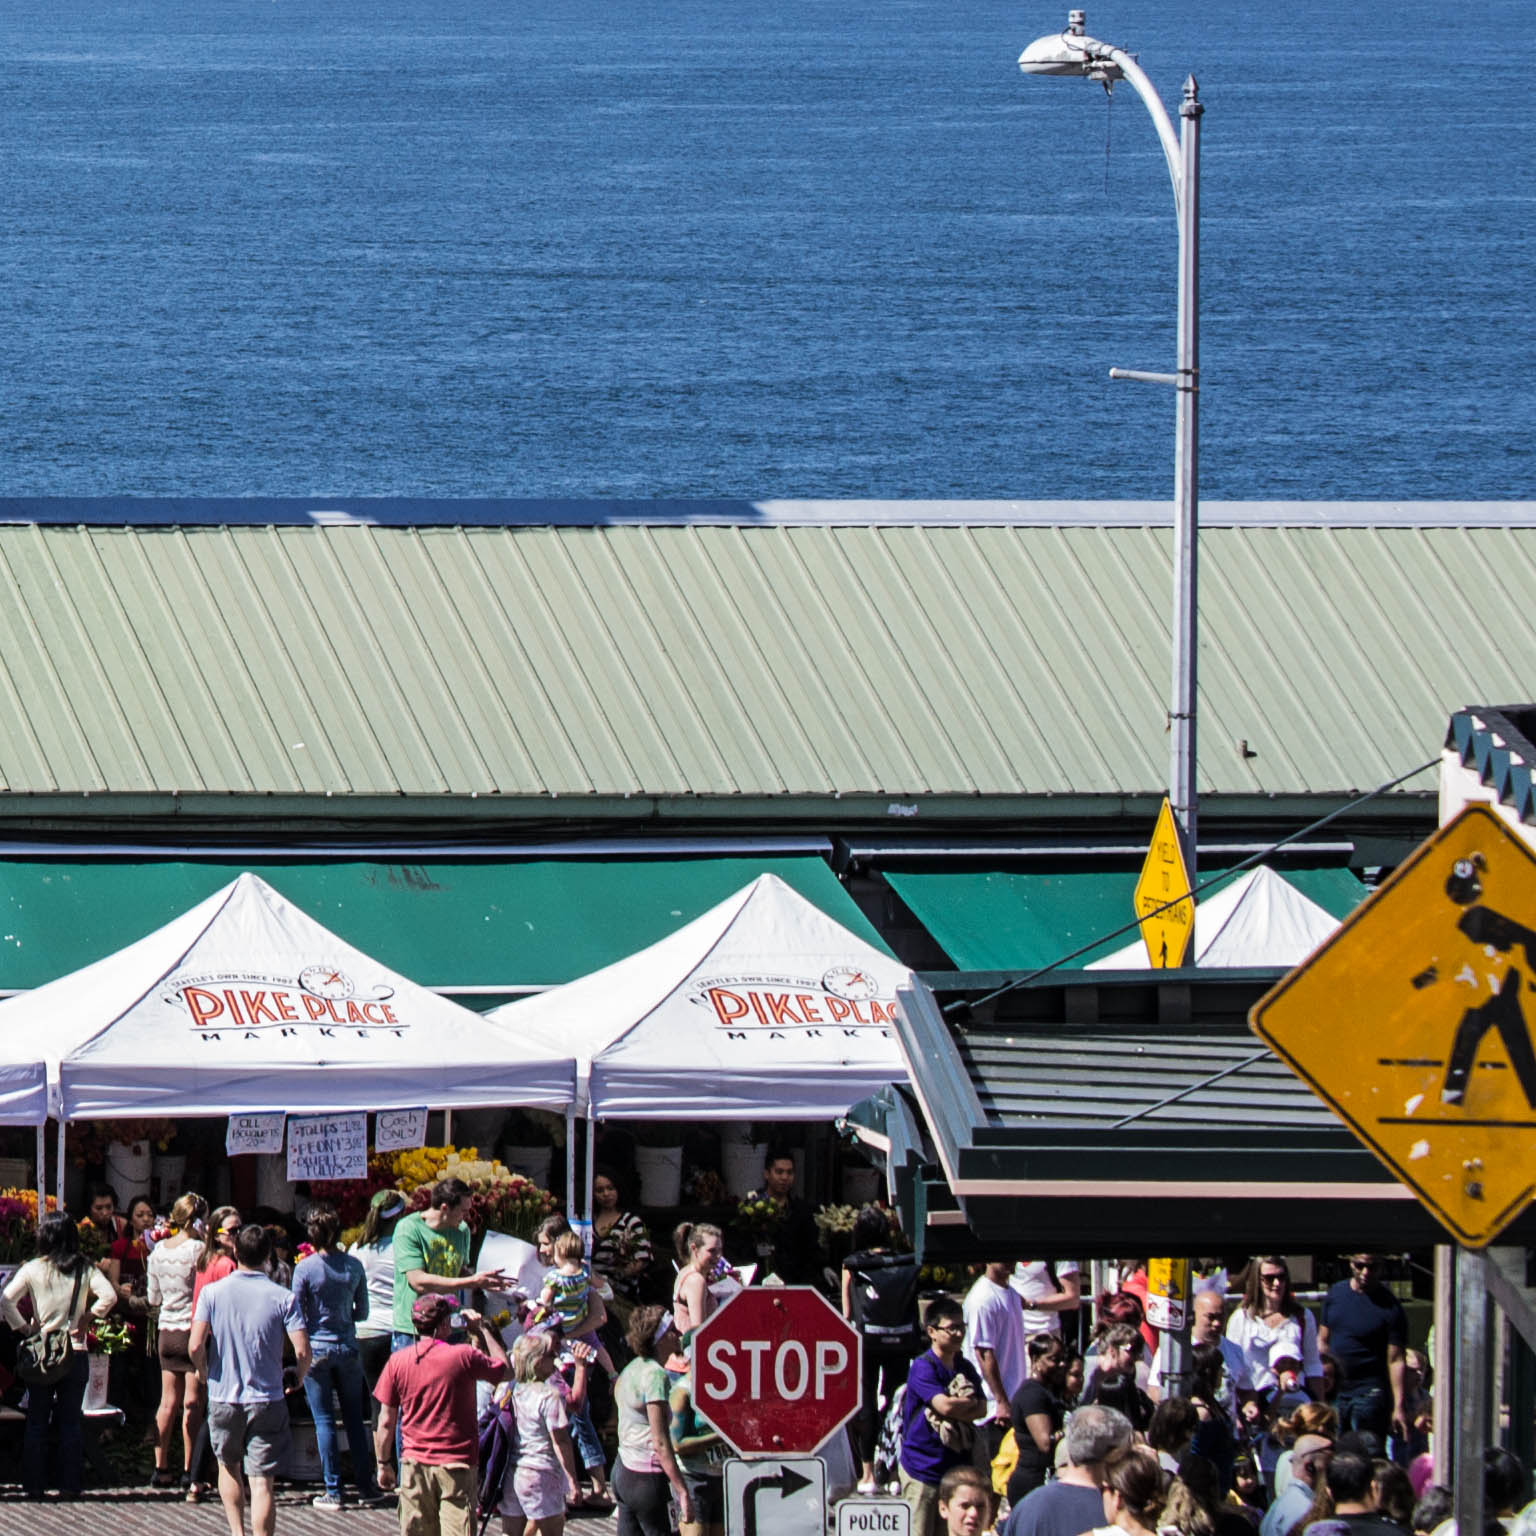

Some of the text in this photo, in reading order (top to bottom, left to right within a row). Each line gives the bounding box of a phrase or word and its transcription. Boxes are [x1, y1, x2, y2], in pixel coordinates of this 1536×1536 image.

[182, 986, 399, 1026] PIKE PLACE
[707, 987, 823, 1025] PIKE
[201, 1028, 404, 1041] MARKET
[727, 1029, 894, 1040] MARKE
[380, 1112, 417, 1130] Cash
[704, 1339, 849, 1400] STOP
[849, 1514, 900, 1531] POLICE
